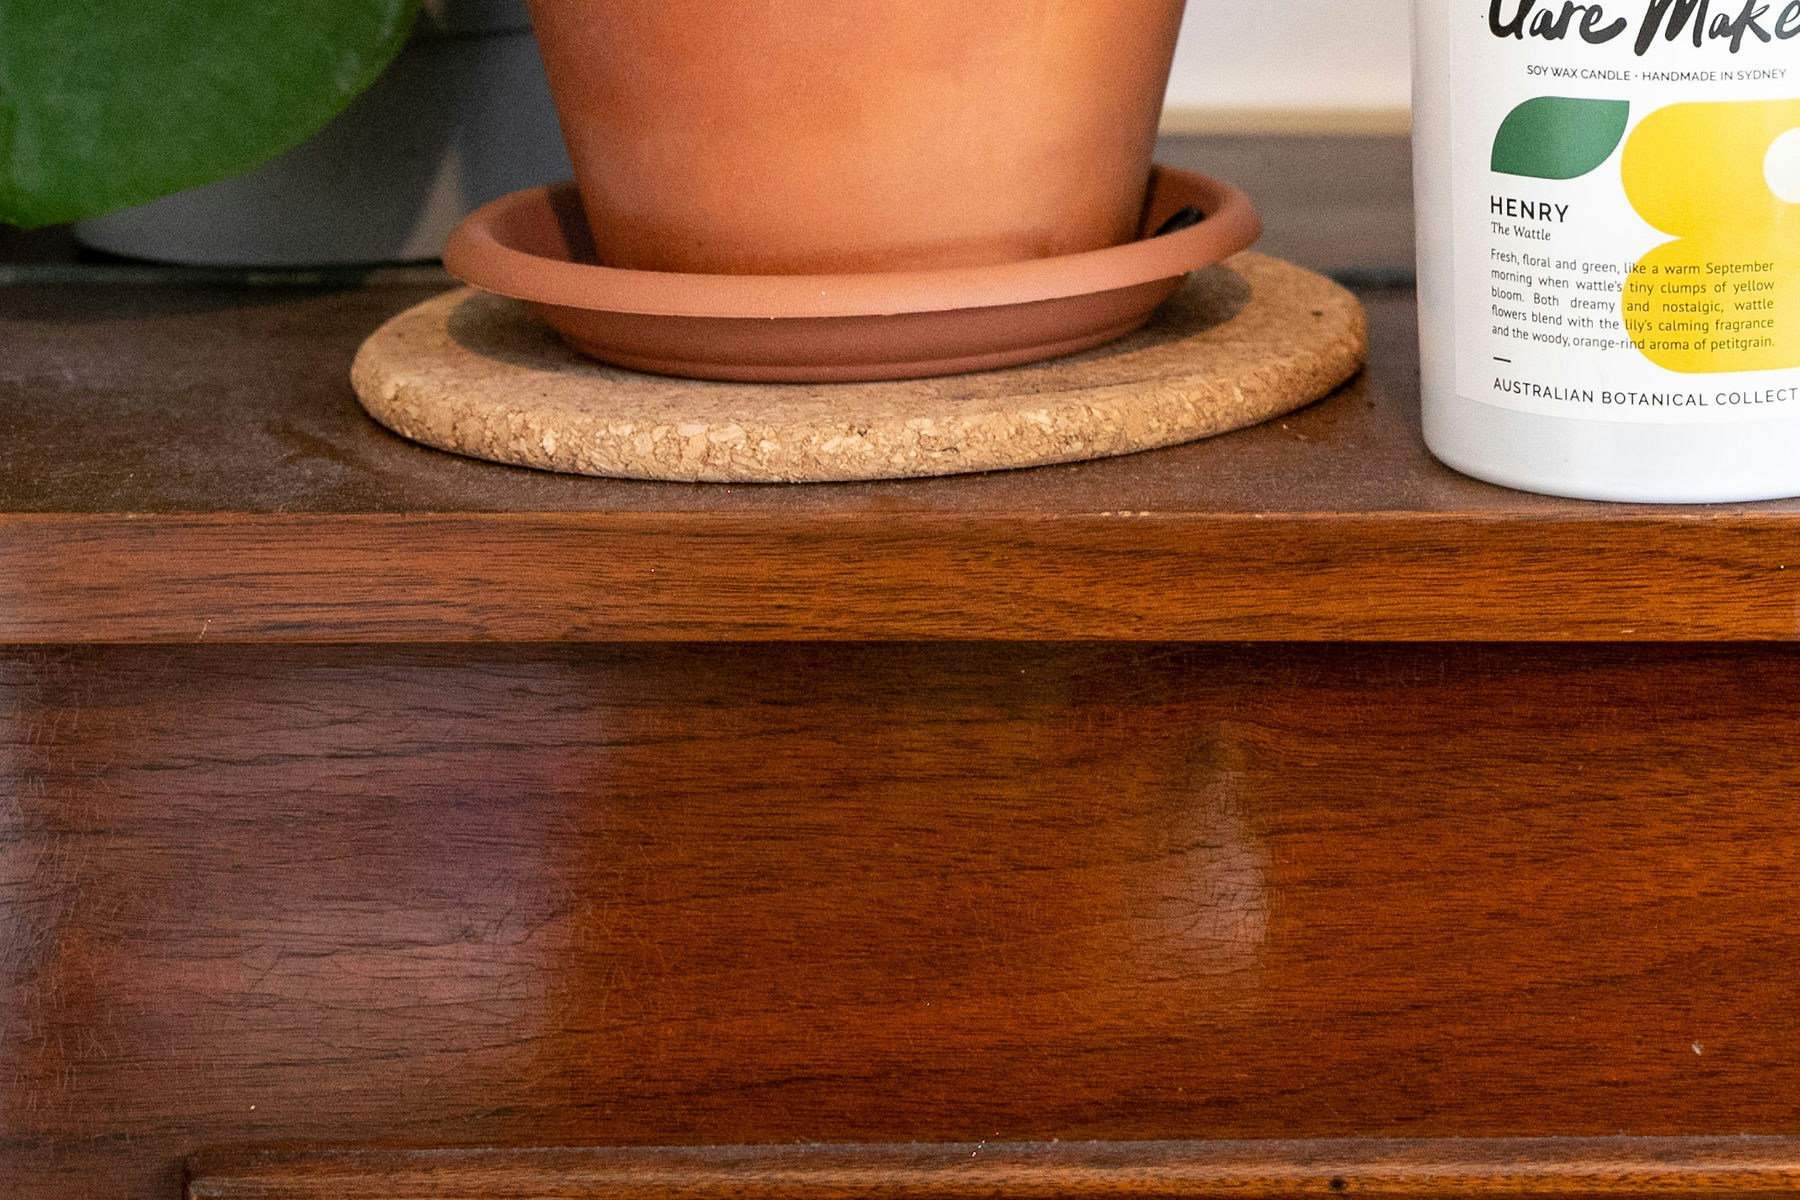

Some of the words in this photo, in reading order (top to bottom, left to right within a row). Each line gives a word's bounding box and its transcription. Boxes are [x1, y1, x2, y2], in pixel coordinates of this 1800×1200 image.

[1527, 64, 1549, 75] SOY
[1551, 67, 1578, 78] WAX
[1581, 69, 1630, 80] CANDLE
[1642, 71, 1717, 81] HANDMADE
[1720, 70, 1733, 80] IN
[1737, 69, 1786, 80] SYDNEY
[1490, 195, 1568, 222] HENRY
[1491, 222, 1510, 236] The
[1514, 226, 1551, 241] Wattle
[1491, 249, 1519, 265] Fresh,
[1522, 254, 1551, 268] floral
[1556, 257, 1577, 270] and
[1582, 261, 1620, 274] green,
[1624, 262, 1646, 274] like
[1652, 264, 1659, 274] a
[1665, 264, 1700, 274] warm
[1706, 261, 1773, 276] September
[1491, 268, 1532, 287] morning
[1538, 275, 1569, 289] when
[1576, 279, 1622, 292] wattle's
[1630, 281, 1653, 296] tiny
[1661, 281, 1706, 296] clumps
[1714, 281, 1727, 293] of
[1733, 279, 1774, 294] yellow
[1492, 286, 1524, 302] bloom.
[1534, 292, 1559, 306] Both
[1571, 296, 1615, 312] dreamy
[1626, 300, 1649, 312] and
[1662, 300, 1723, 314] nostalgic,
[1734, 298, 1773, 311] wattle
[1492, 305, 1527, 321] flowers
[1532, 311, 1562, 326] blend
[1568, 314, 1594, 328] with
[1599, 318, 1619, 330] the
[1625, 319, 1652, 334] lily's
[1659, 319, 1709, 334] calming
[1715, 318, 1773, 332] fragrance
[1492, 324, 1509, 337] and
[1512, 326, 1528, 340] the
[1532, 331, 1570, 348] woody,
[1573, 335, 1645, 351] orange-rind
[1650, 339, 1689, 350] aroma
[1694, 337, 1708, 350] of
[1711, 336, 1774, 352] petitgrain.
[1493, 377, 1594, 403] AUSTRALIAN
[1602, 391, 1708, 406] BOTANICAL
